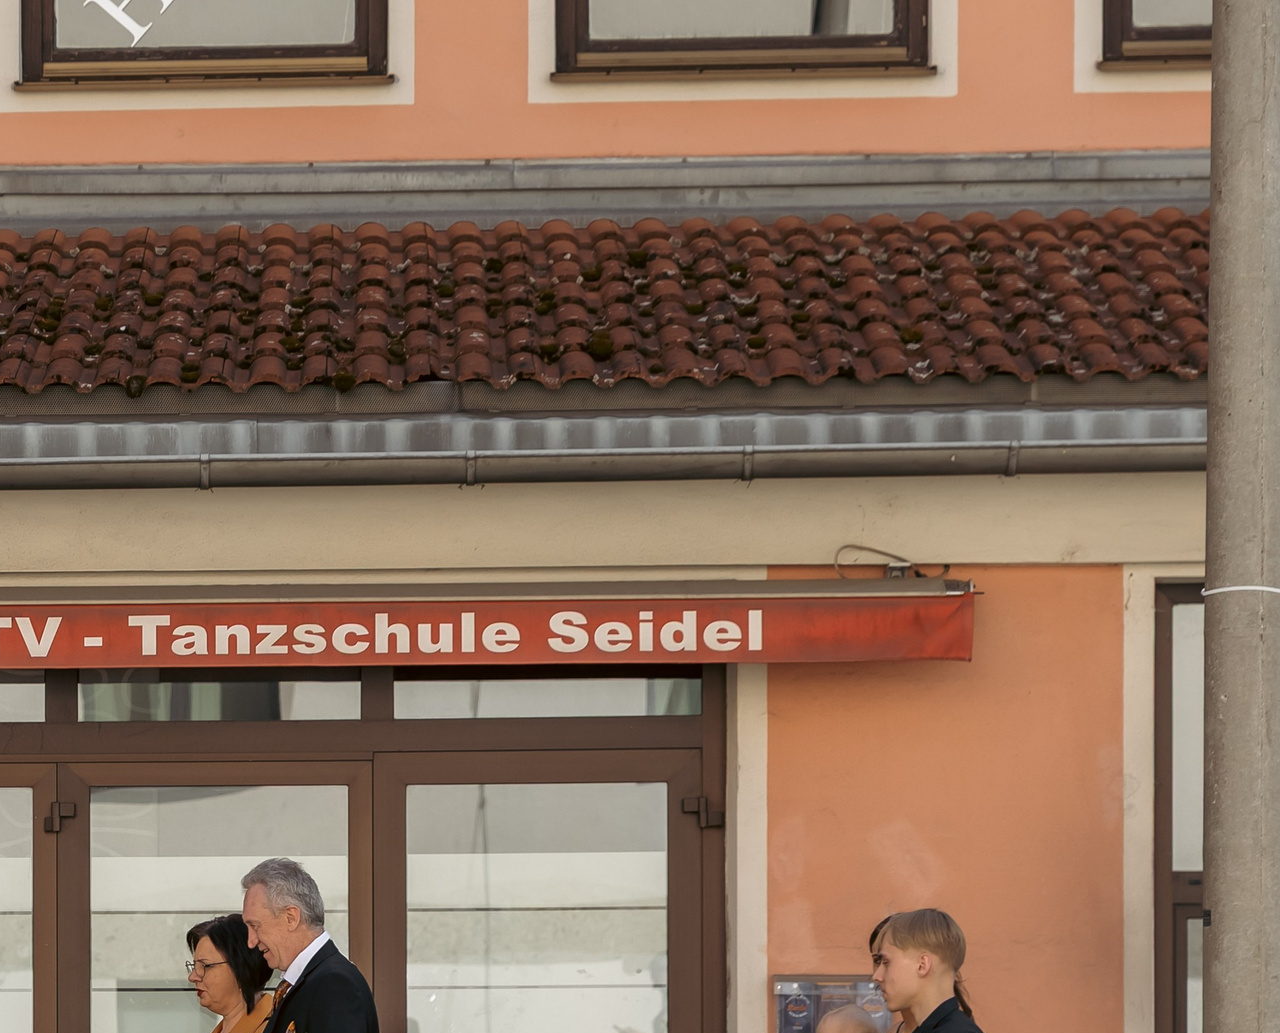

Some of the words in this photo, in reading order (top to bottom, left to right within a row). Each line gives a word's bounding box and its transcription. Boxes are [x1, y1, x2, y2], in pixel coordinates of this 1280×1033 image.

[83, 636, 103, 647] -
[128, 612, 521, 656] Tanzschule
[547, 609, 763, 653] Seidel
